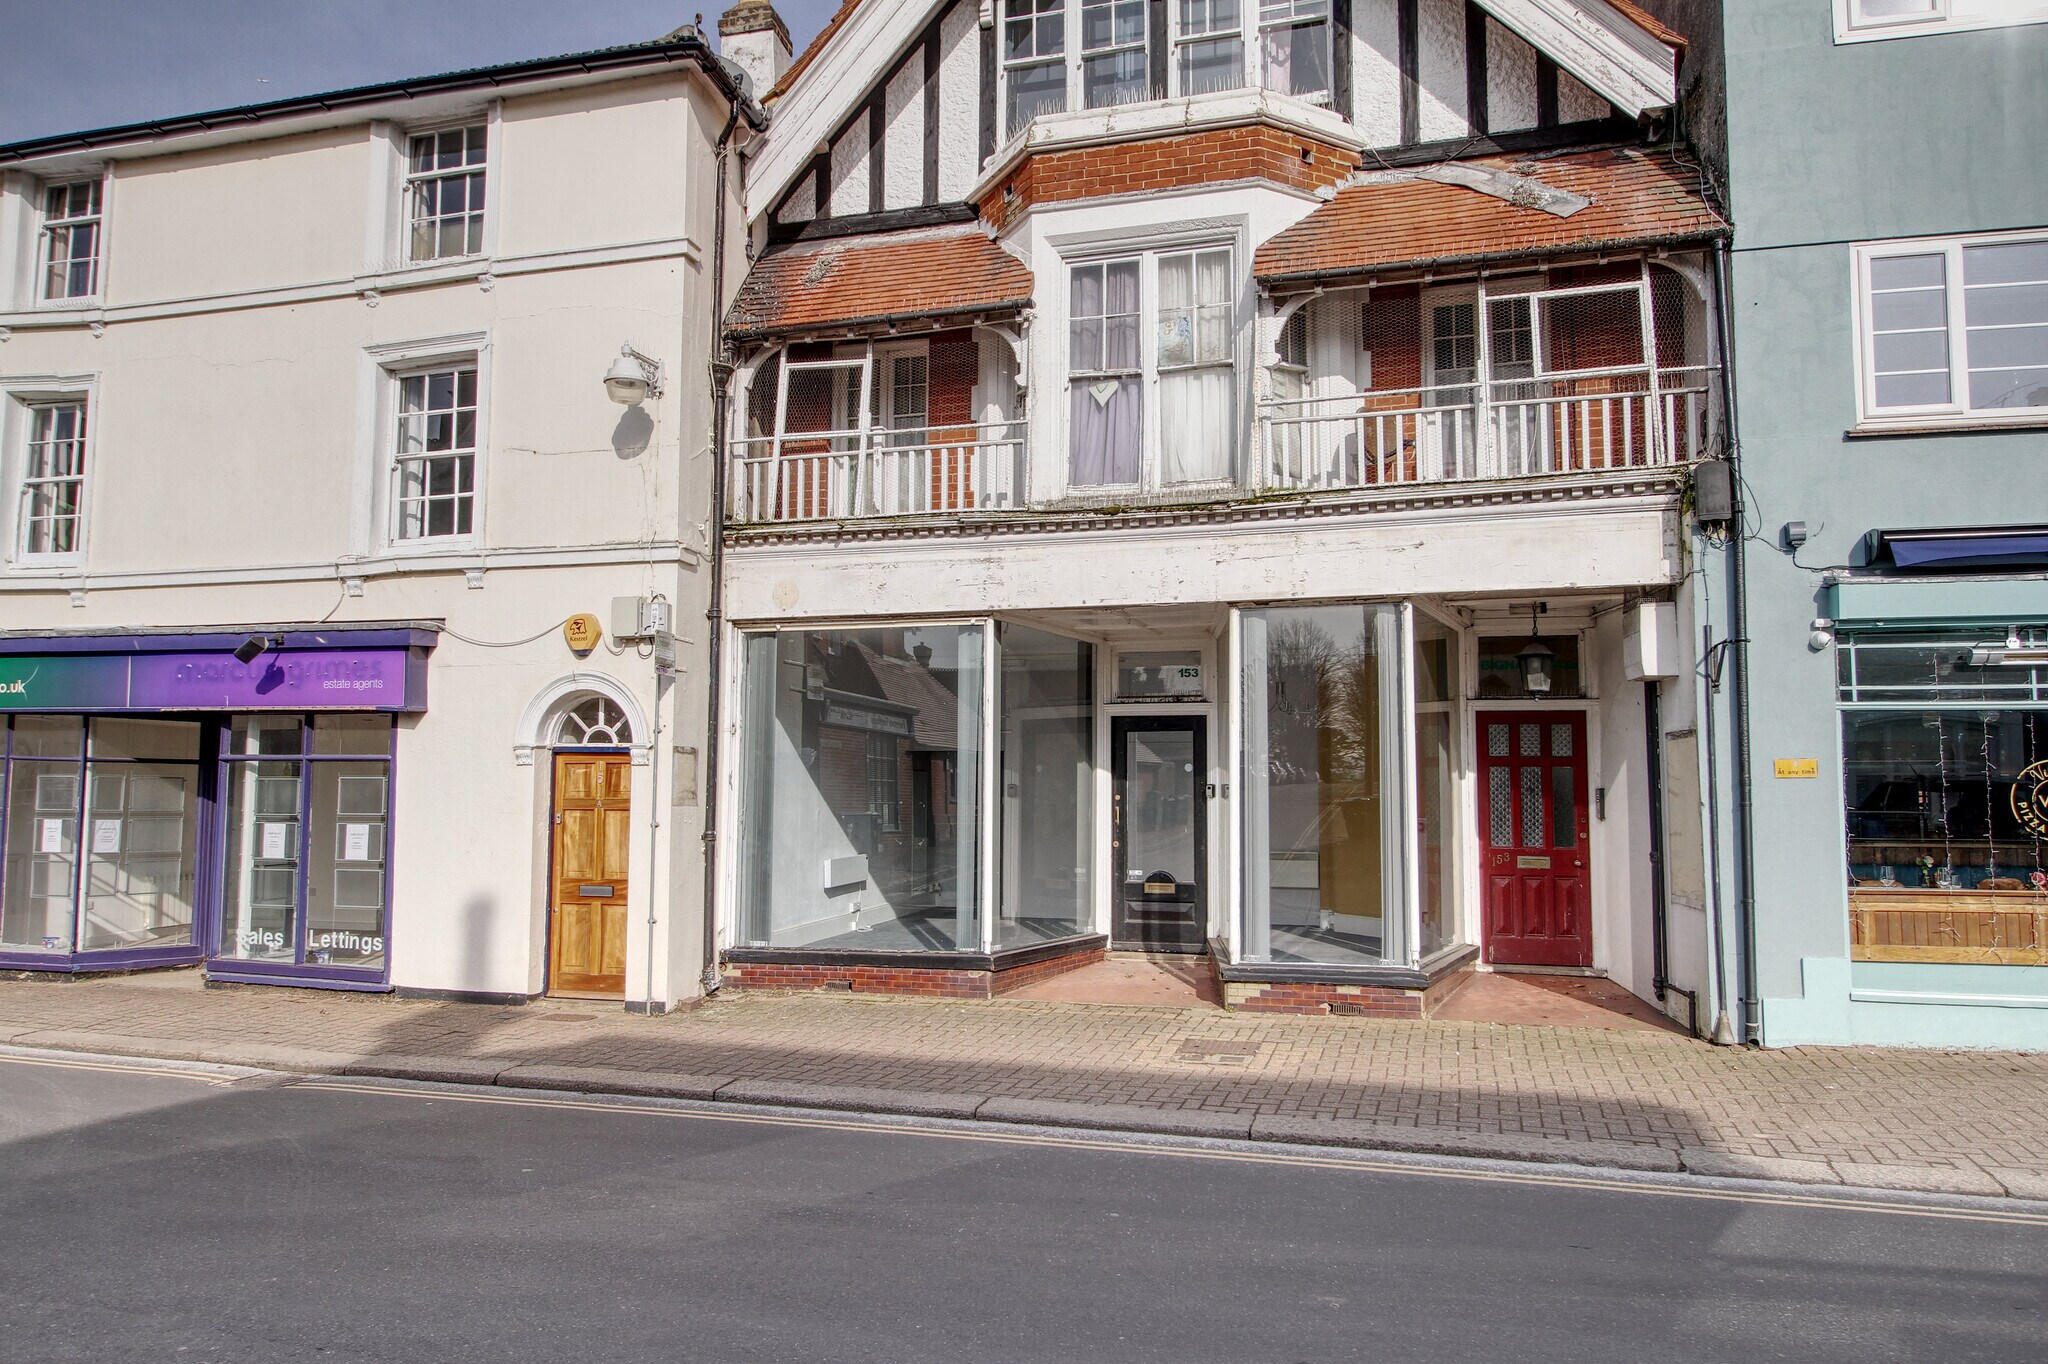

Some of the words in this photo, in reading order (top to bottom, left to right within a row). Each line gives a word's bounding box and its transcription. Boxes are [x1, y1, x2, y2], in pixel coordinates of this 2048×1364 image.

[1178, 668, 1199, 678] 153
[323, 679, 351, 689] estate
[352, 679, 384, 691] agents
[2017, 801, 2046, 834] PIZZA
[1492, 852, 1510, 867] 153
[309, 929, 383, 955] Lettings
